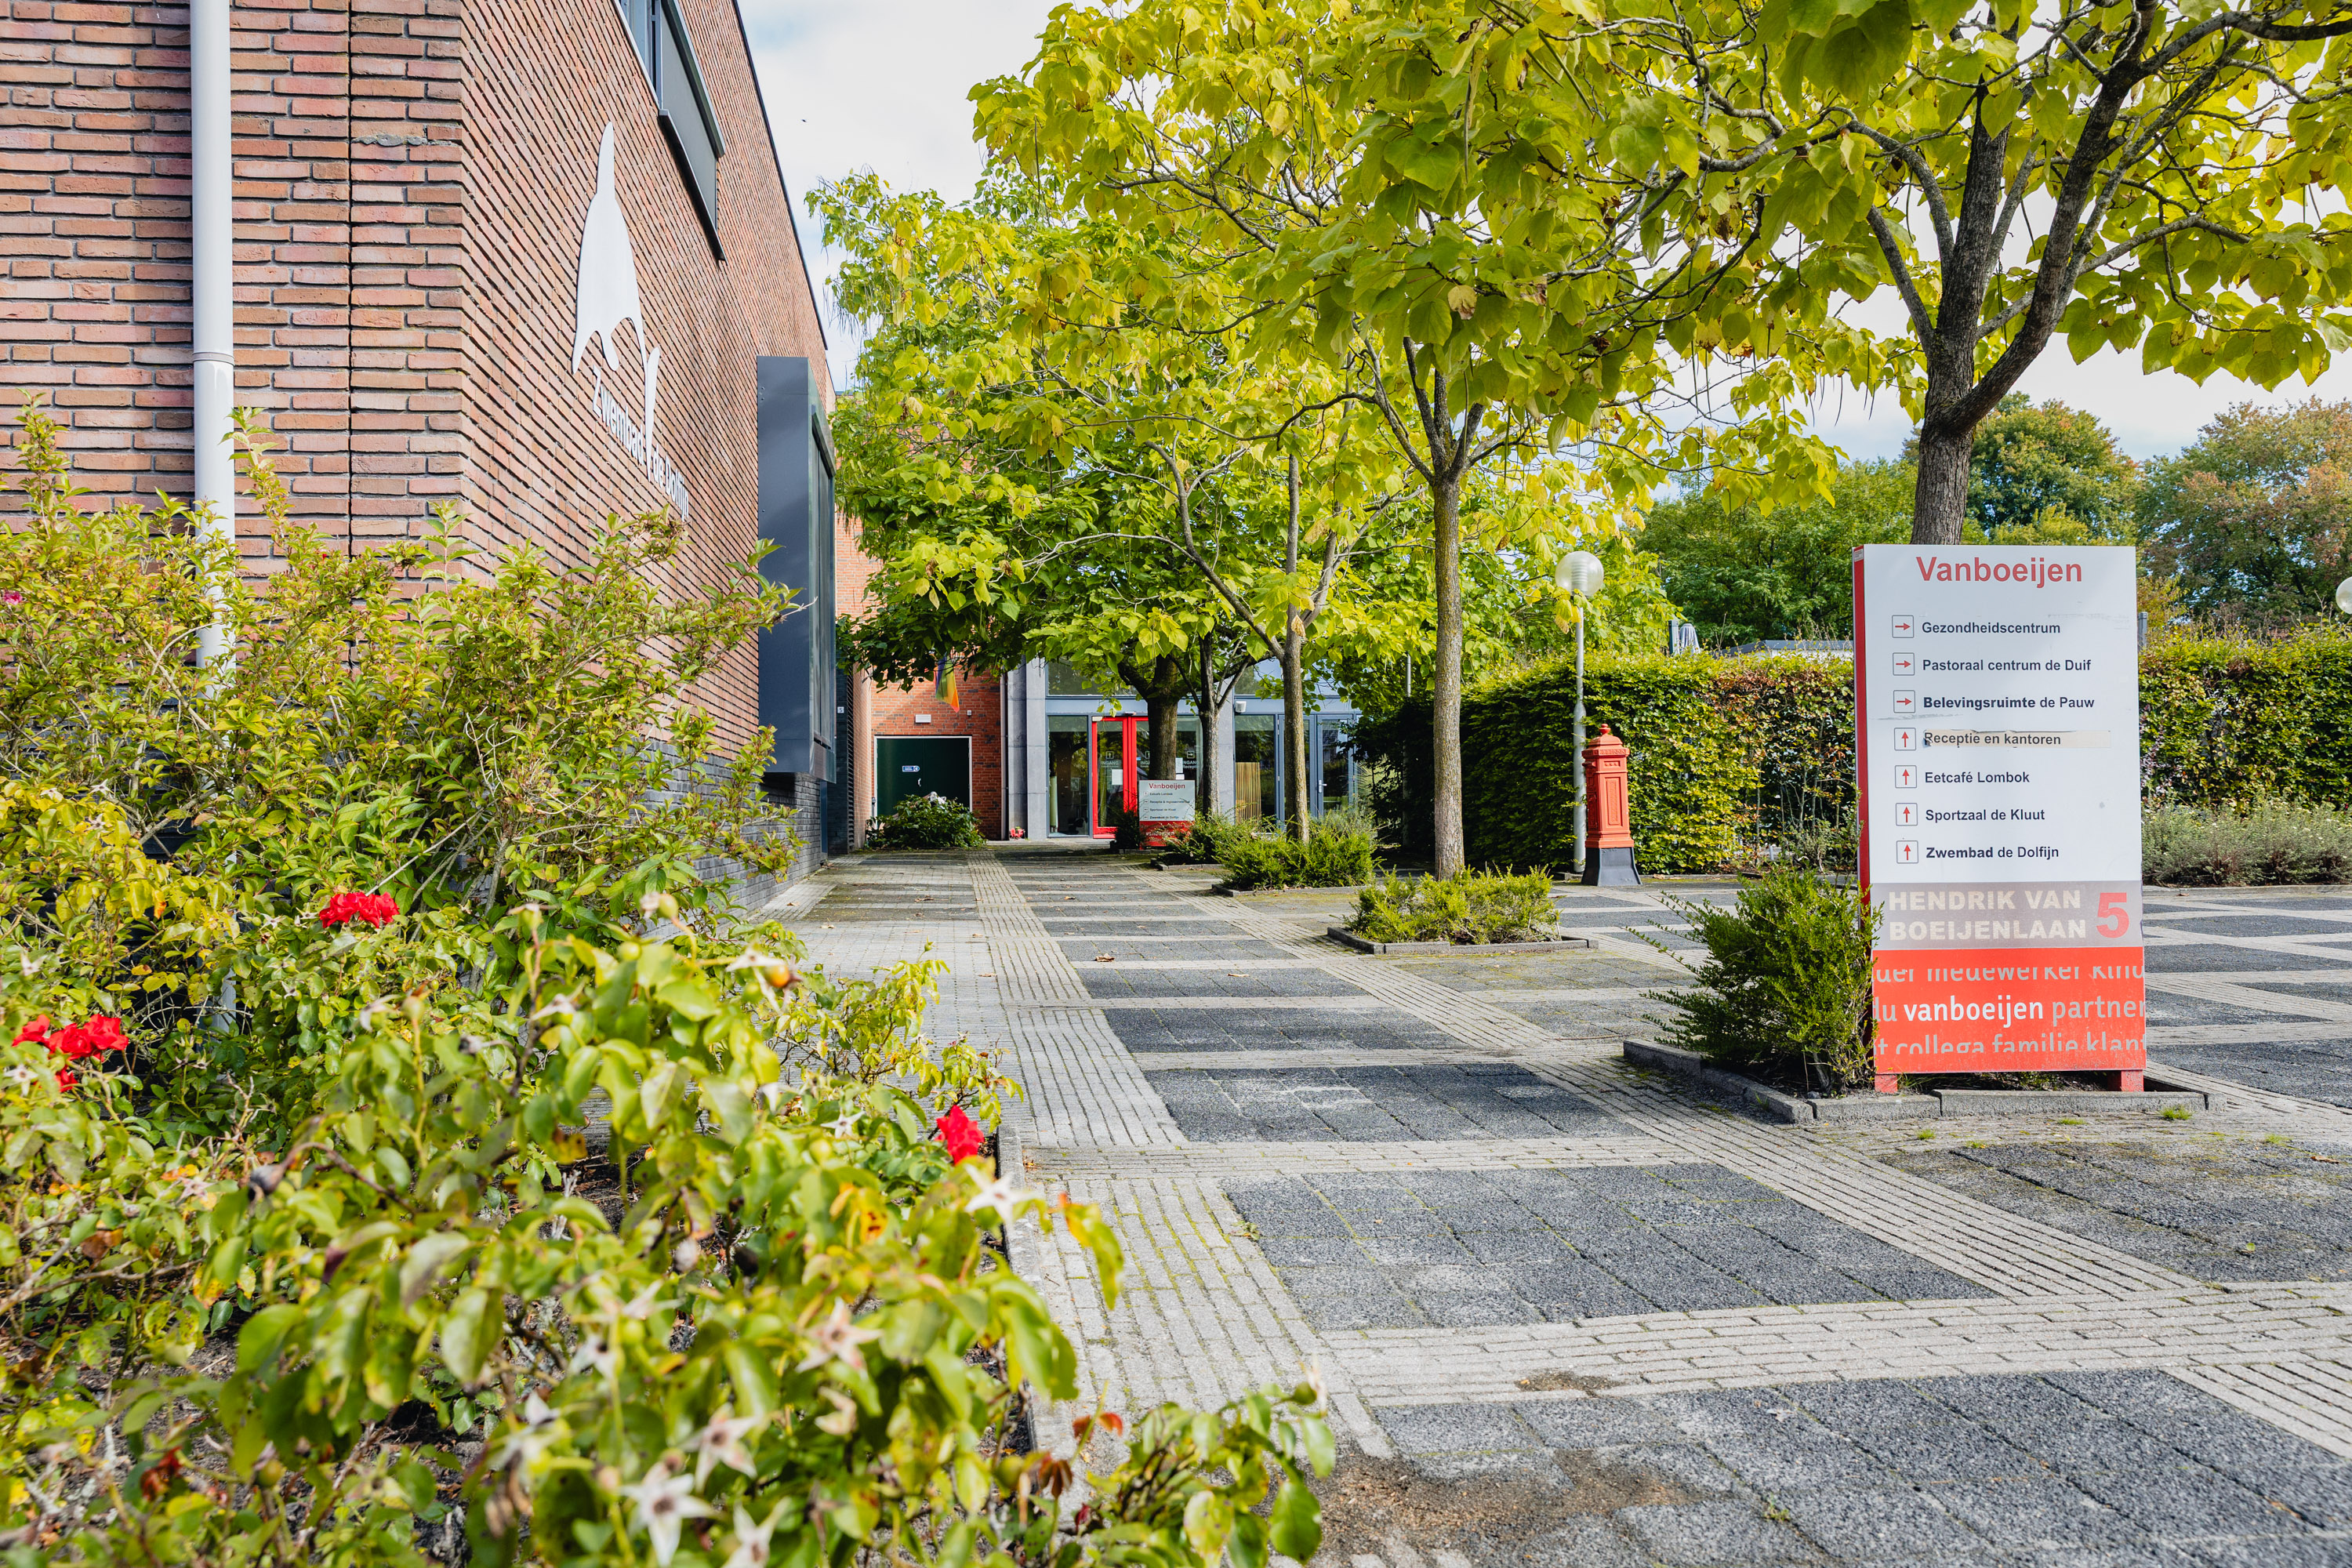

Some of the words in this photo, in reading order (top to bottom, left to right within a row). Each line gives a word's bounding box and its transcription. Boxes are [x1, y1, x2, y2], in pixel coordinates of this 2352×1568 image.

[593, 364, 644, 466] Zwembad
[652, 444, 664, 488] de
[665, 456, 689, 522] Dolfijn
[1916, 557, 2082, 588] Vanboeijen
[1922, 622, 2060, 633] Gezondheidscentrum
[1922, 659, 1984, 671] Pastoraal
[1987, 660, 2041, 671] centrum
[2045, 659, 2061, 671] de
[2065, 659, 2092, 671] Duif
[1923, 696, 2036, 710] Belevingsruimte
[2039, 696, 2056, 708] de
[2060, 696, 2095, 708] Pauw
[1924, 732, 1980, 748] Receptie
[1984, 733, 2000, 744] en
[2004, 733, 2061, 745] kantoren
[1925, 771, 1973, 783] Eetcafé
[1977, 771, 2030, 783] Lombok
[1926, 809, 1987, 823] Sportzaal
[1991, 809, 2006, 821] de
[2010, 808, 2045, 820] Kluut
[1926, 847, 1994, 858] Zwembad
[1998, 846, 2013, 858] de
[2017, 846, 2059, 860] Dolfijn
[1889, 890, 2016, 910] HENDRIK
[2024, 890, 2081, 909] VAN
[2096, 892, 2129, 938] 5
[1889, 920, 2086, 941] BOEIJENLAAN
[1903, 994, 2044, 1028] vanboeijen
